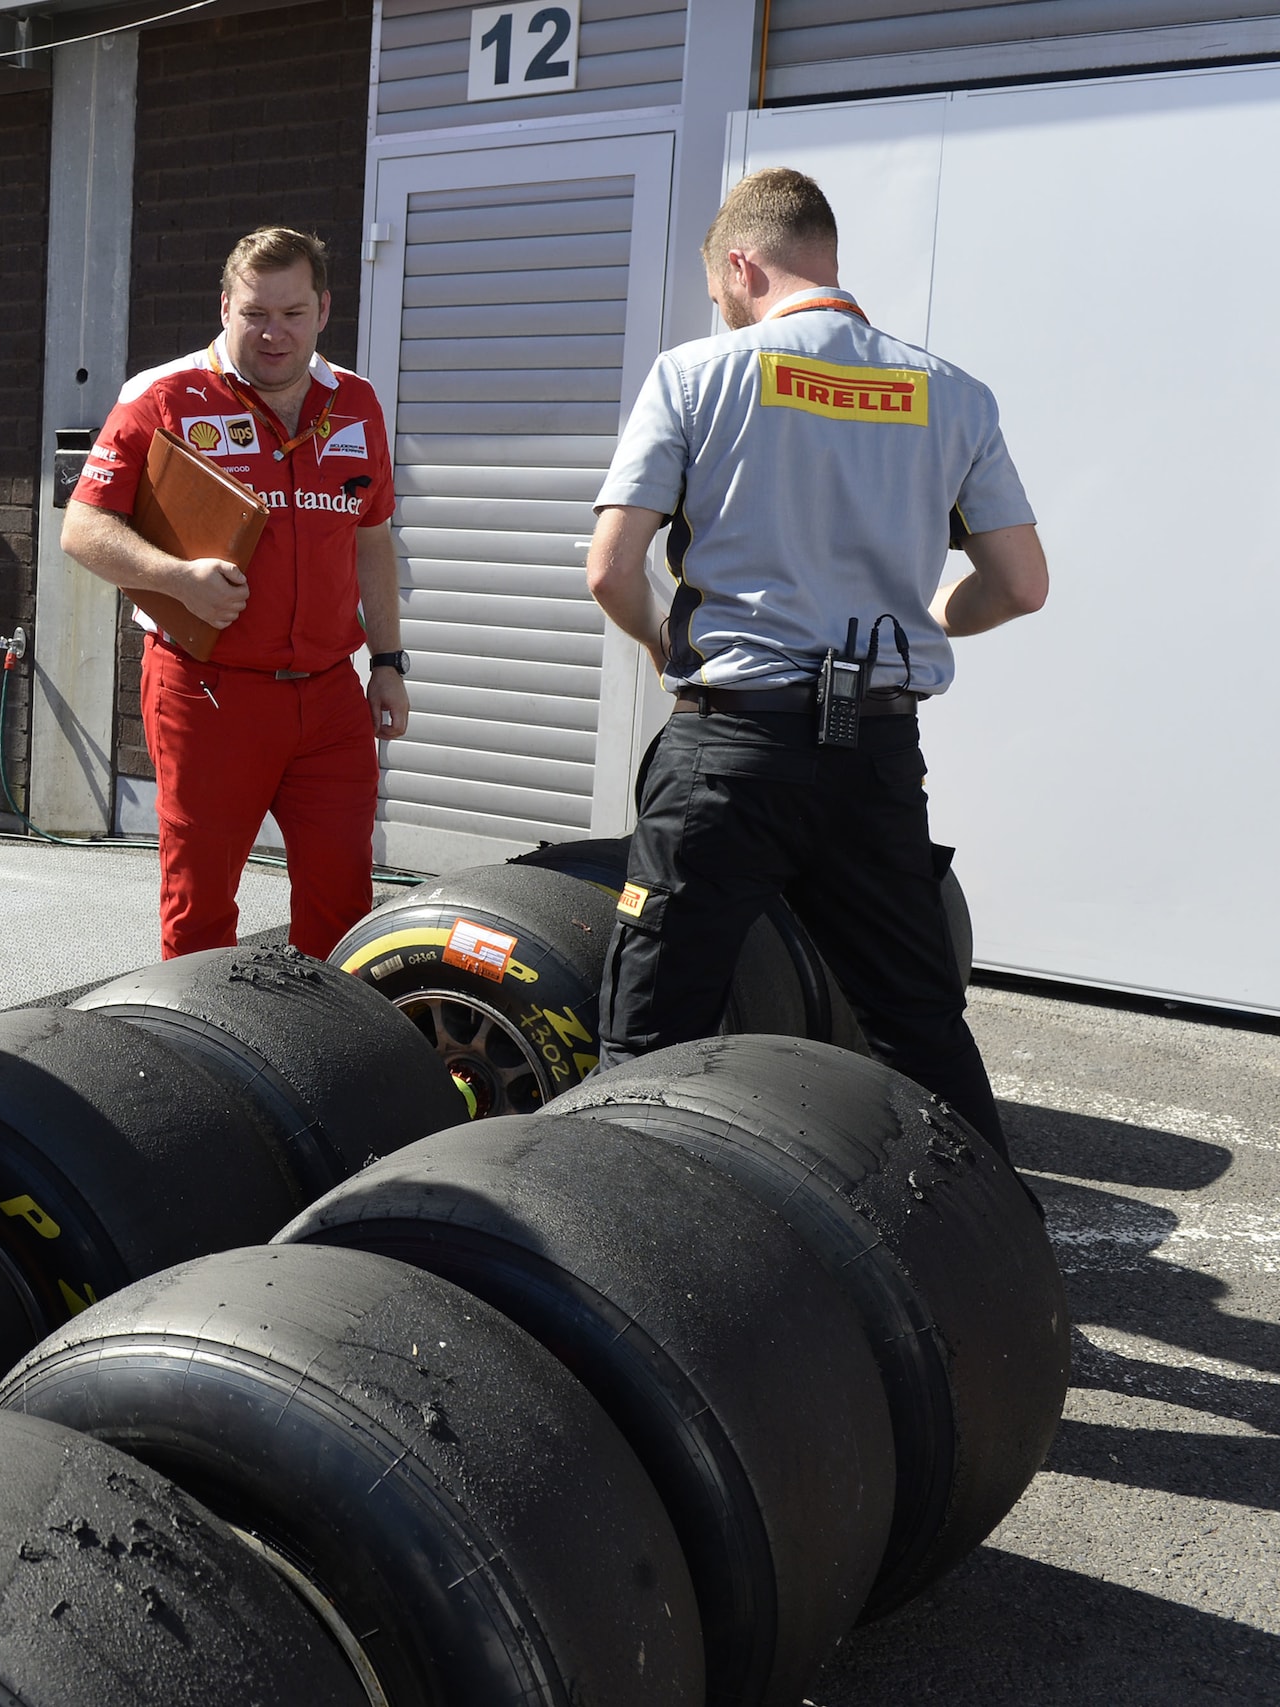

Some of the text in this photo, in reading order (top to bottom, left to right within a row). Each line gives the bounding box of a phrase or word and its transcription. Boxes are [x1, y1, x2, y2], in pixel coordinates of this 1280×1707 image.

[481, 7, 571, 85] 12
[776, 365, 915, 412] PIRELLI
[229, 426, 253, 444] ups
[521, 1003, 570, 1082] 7302
